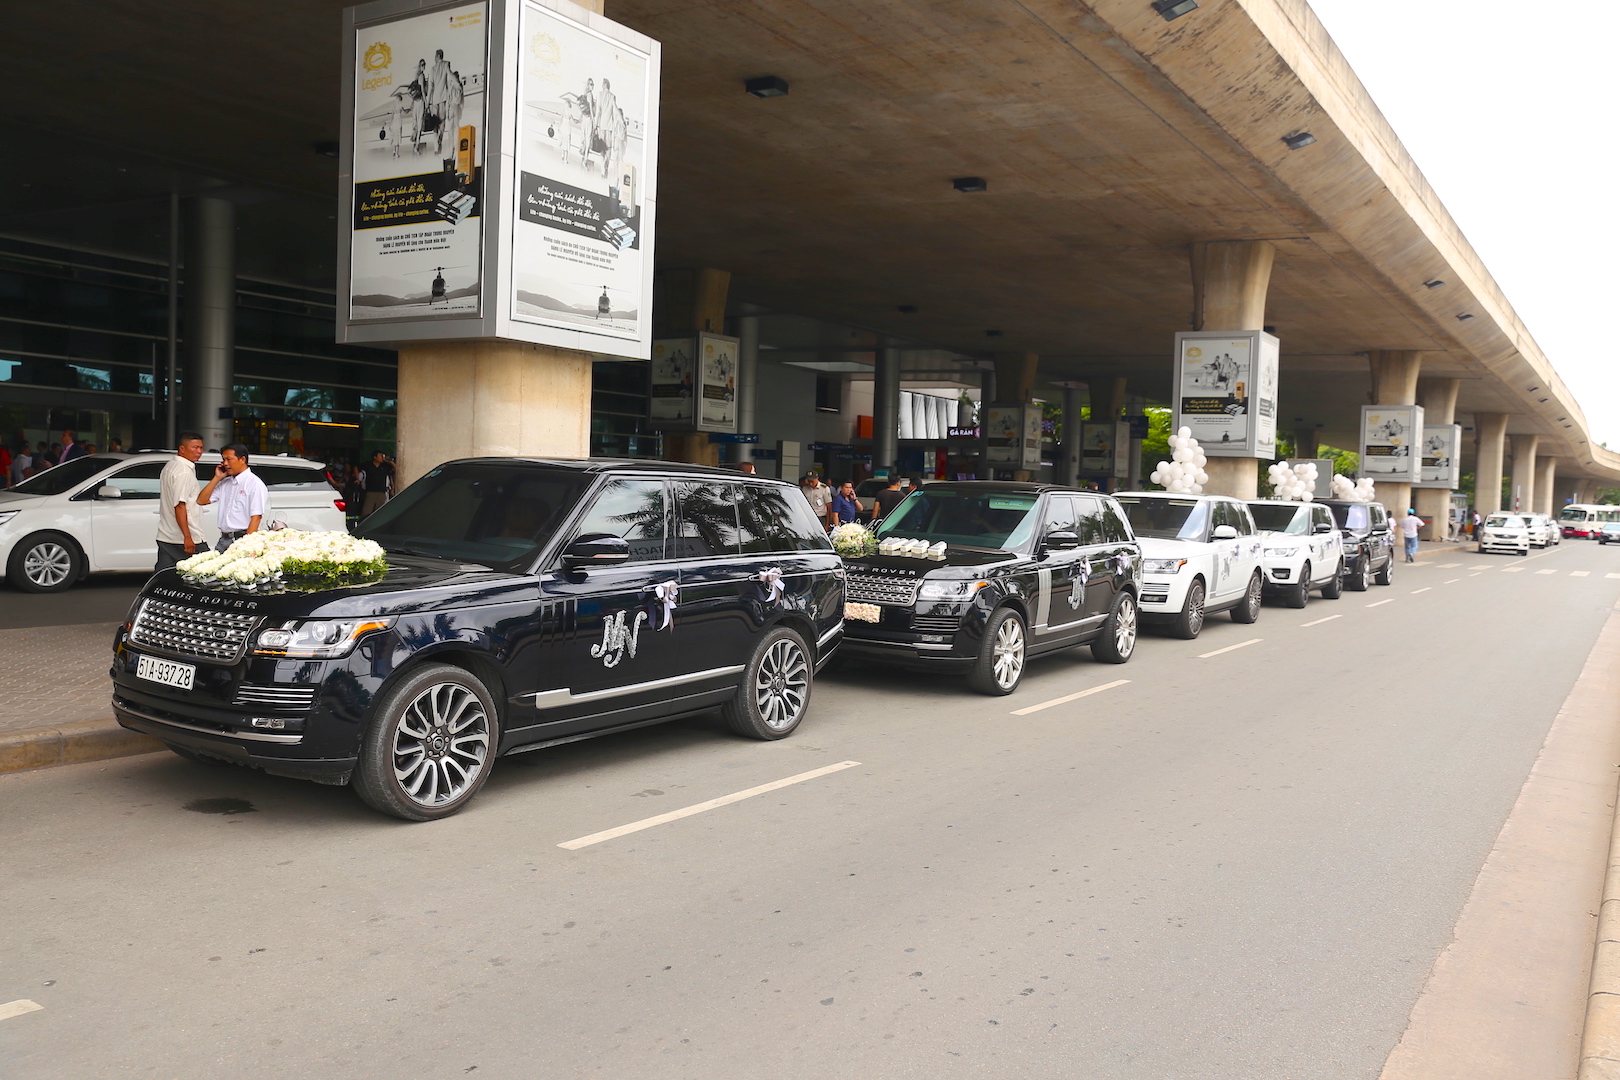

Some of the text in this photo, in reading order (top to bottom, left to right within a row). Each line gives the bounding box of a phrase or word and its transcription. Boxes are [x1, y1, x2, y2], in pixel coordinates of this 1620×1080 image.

[361, 72, 392, 91] Legend
[872, 567, 916, 576] ROVER
[154, 587, 258, 610] RANGE ROVER
[138, 658, 191, 687] 51A-937.28
